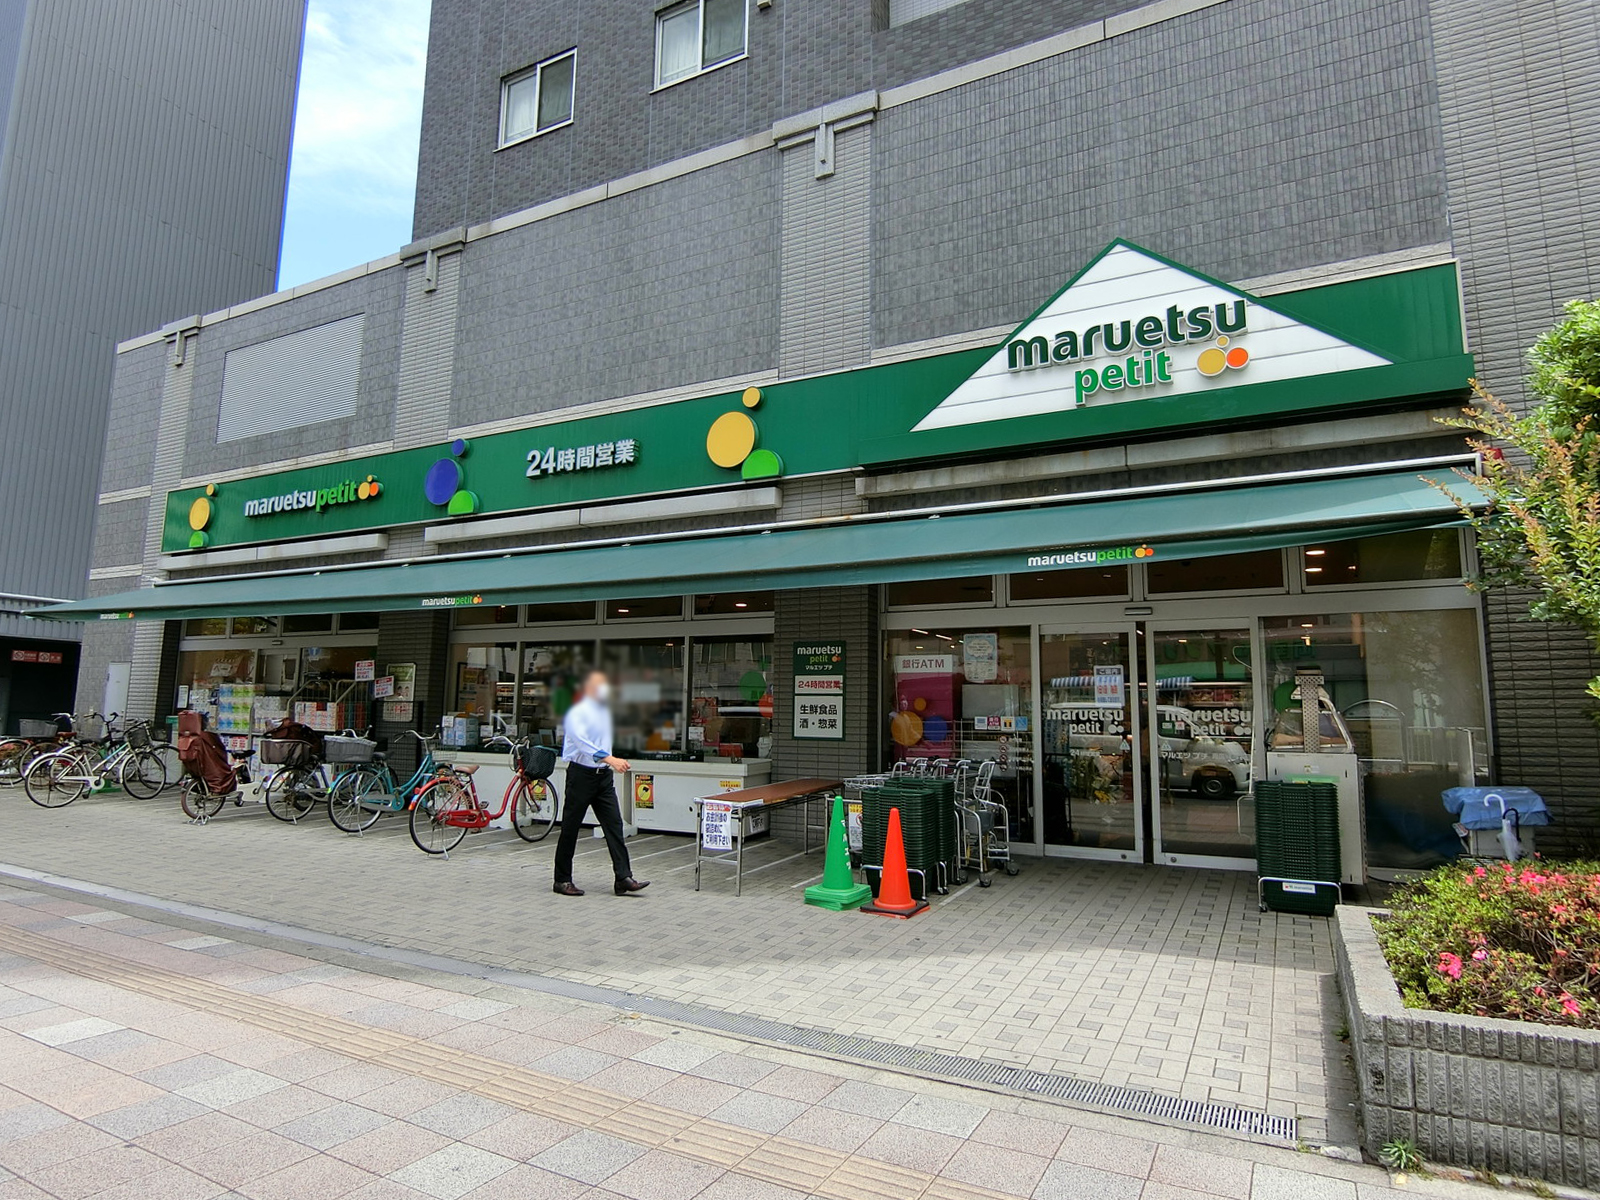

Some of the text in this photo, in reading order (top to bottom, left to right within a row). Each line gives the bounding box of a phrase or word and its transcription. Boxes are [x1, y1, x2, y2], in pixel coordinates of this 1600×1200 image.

[1008, 299, 1247, 371] maruetsu
[1075, 349, 1173, 406] petit
[526, 439, 636, 477] 24時間営業
[244, 480, 357, 517] maruetsupetit
[1027, 547, 1133, 567] maruetsupetit
[797, 646, 842, 655] maruetsu
[809, 655, 828, 664] petit
[902, 659, 945, 669] 銀行ATM
[798, 680, 842, 690] 24時間営業
[799, 704, 838, 716] 生鮮食品
[1046, 708, 1124, 721] maruetsu
[1164, 708, 1252, 722] maruetsu
[1069, 721, 1101, 734] petit
[1190, 722, 1226, 738] petit
[1160, 751, 1191, 759] マルエツ
